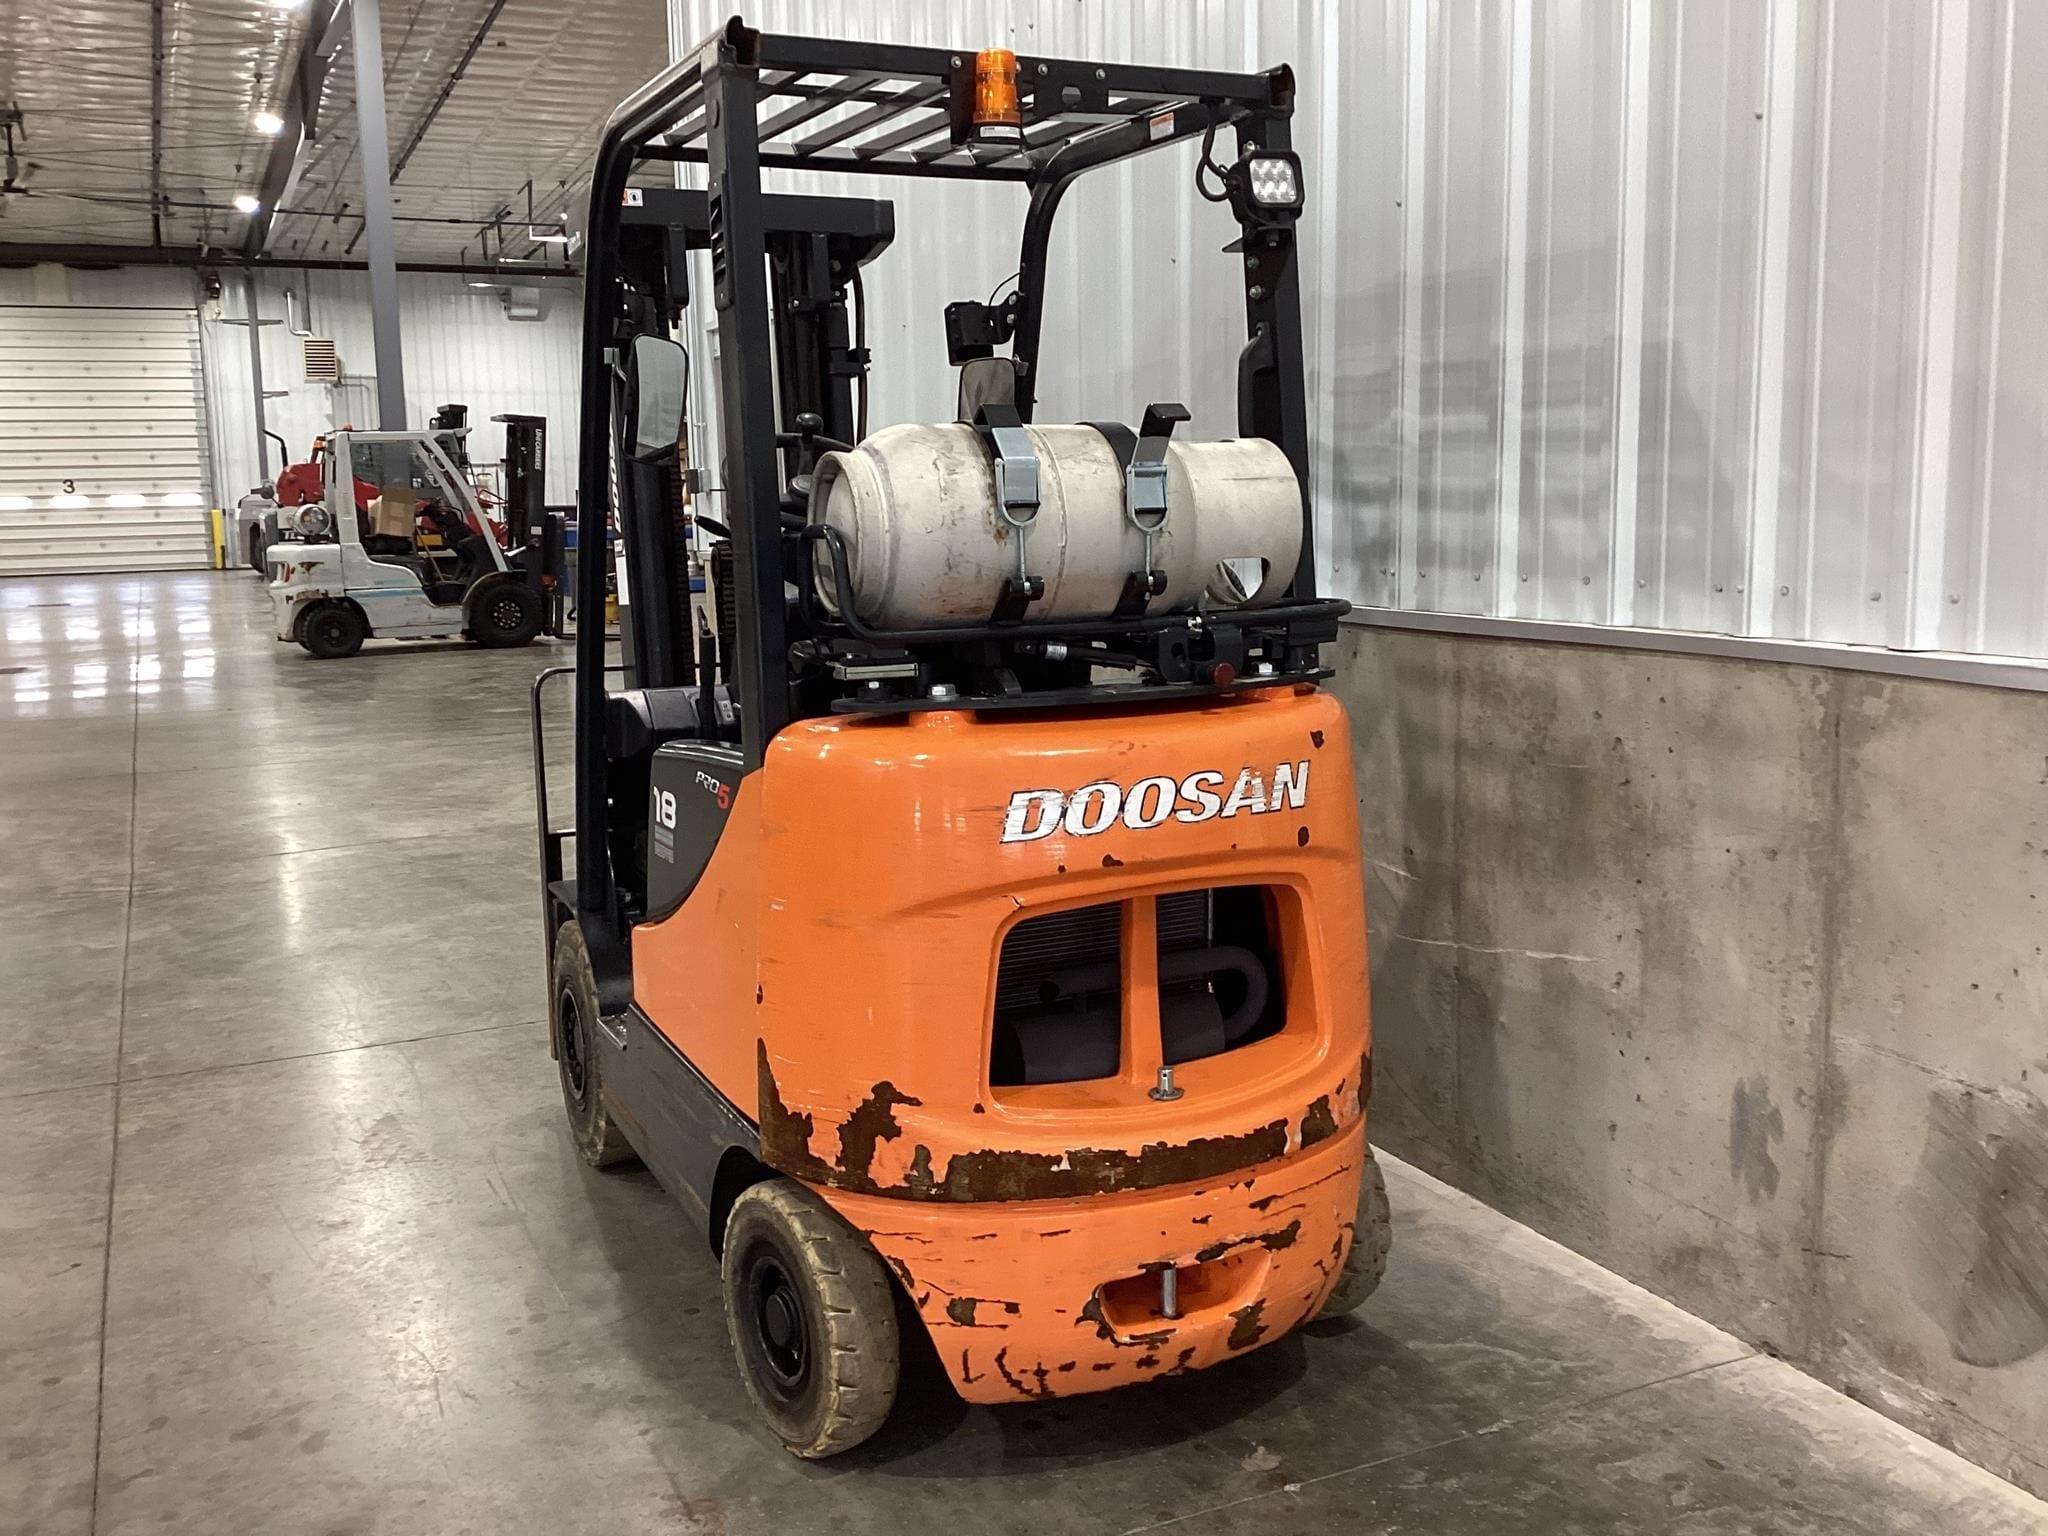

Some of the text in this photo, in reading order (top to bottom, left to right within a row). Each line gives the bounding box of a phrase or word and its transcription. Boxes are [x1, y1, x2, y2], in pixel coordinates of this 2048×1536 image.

[62, 479, 75, 494] 3
[653, 786, 676, 829] 18
[1000, 760, 1309, 844] DOOSAN
